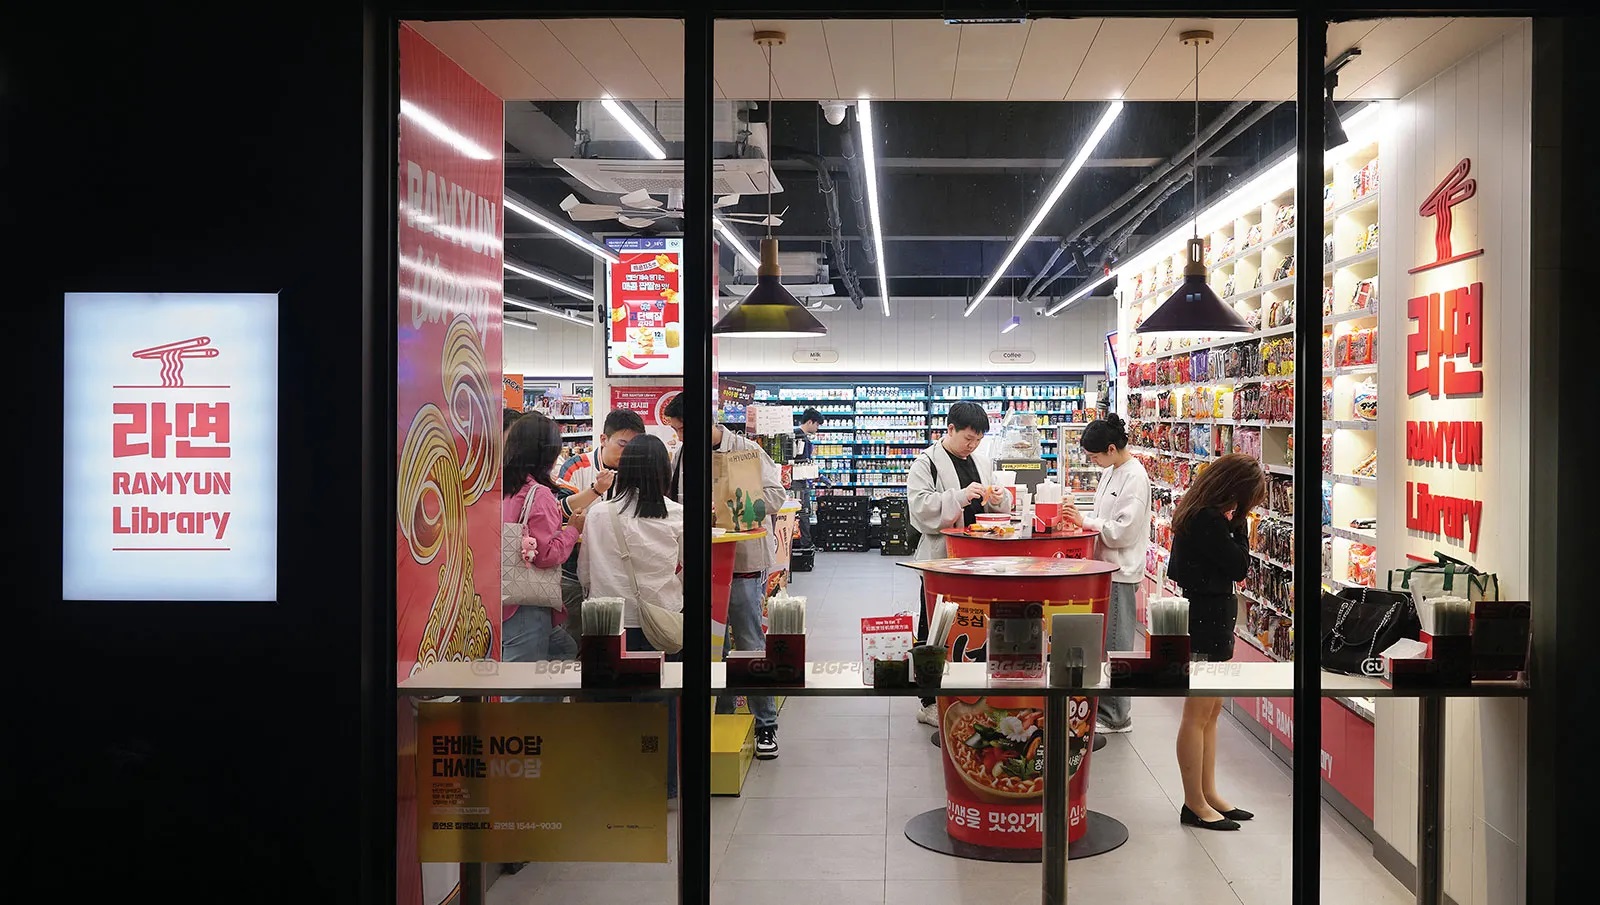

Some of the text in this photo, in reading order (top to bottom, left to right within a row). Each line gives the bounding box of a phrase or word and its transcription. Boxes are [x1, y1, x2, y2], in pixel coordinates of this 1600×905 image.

[407, 160, 496, 258] RAMYUN
[1407, 282, 1484, 398] 라면
[112, 402, 231, 458] 라면
[1406, 421, 1483, 465] RAMYUN
[112, 472, 231, 495] RAMYUN
[112, 506, 231, 540] Library
[1406, 481, 1483, 554] Library
[957, 613, 984, 628] 농심
[812, 660, 862, 674] BGF리
[432, 735, 483, 755] 담배는
[432, 758, 487, 778] 대세는
[516, 822, 562, 830] 1544-9030
[988, 811, 1043, 833] 맛있게
